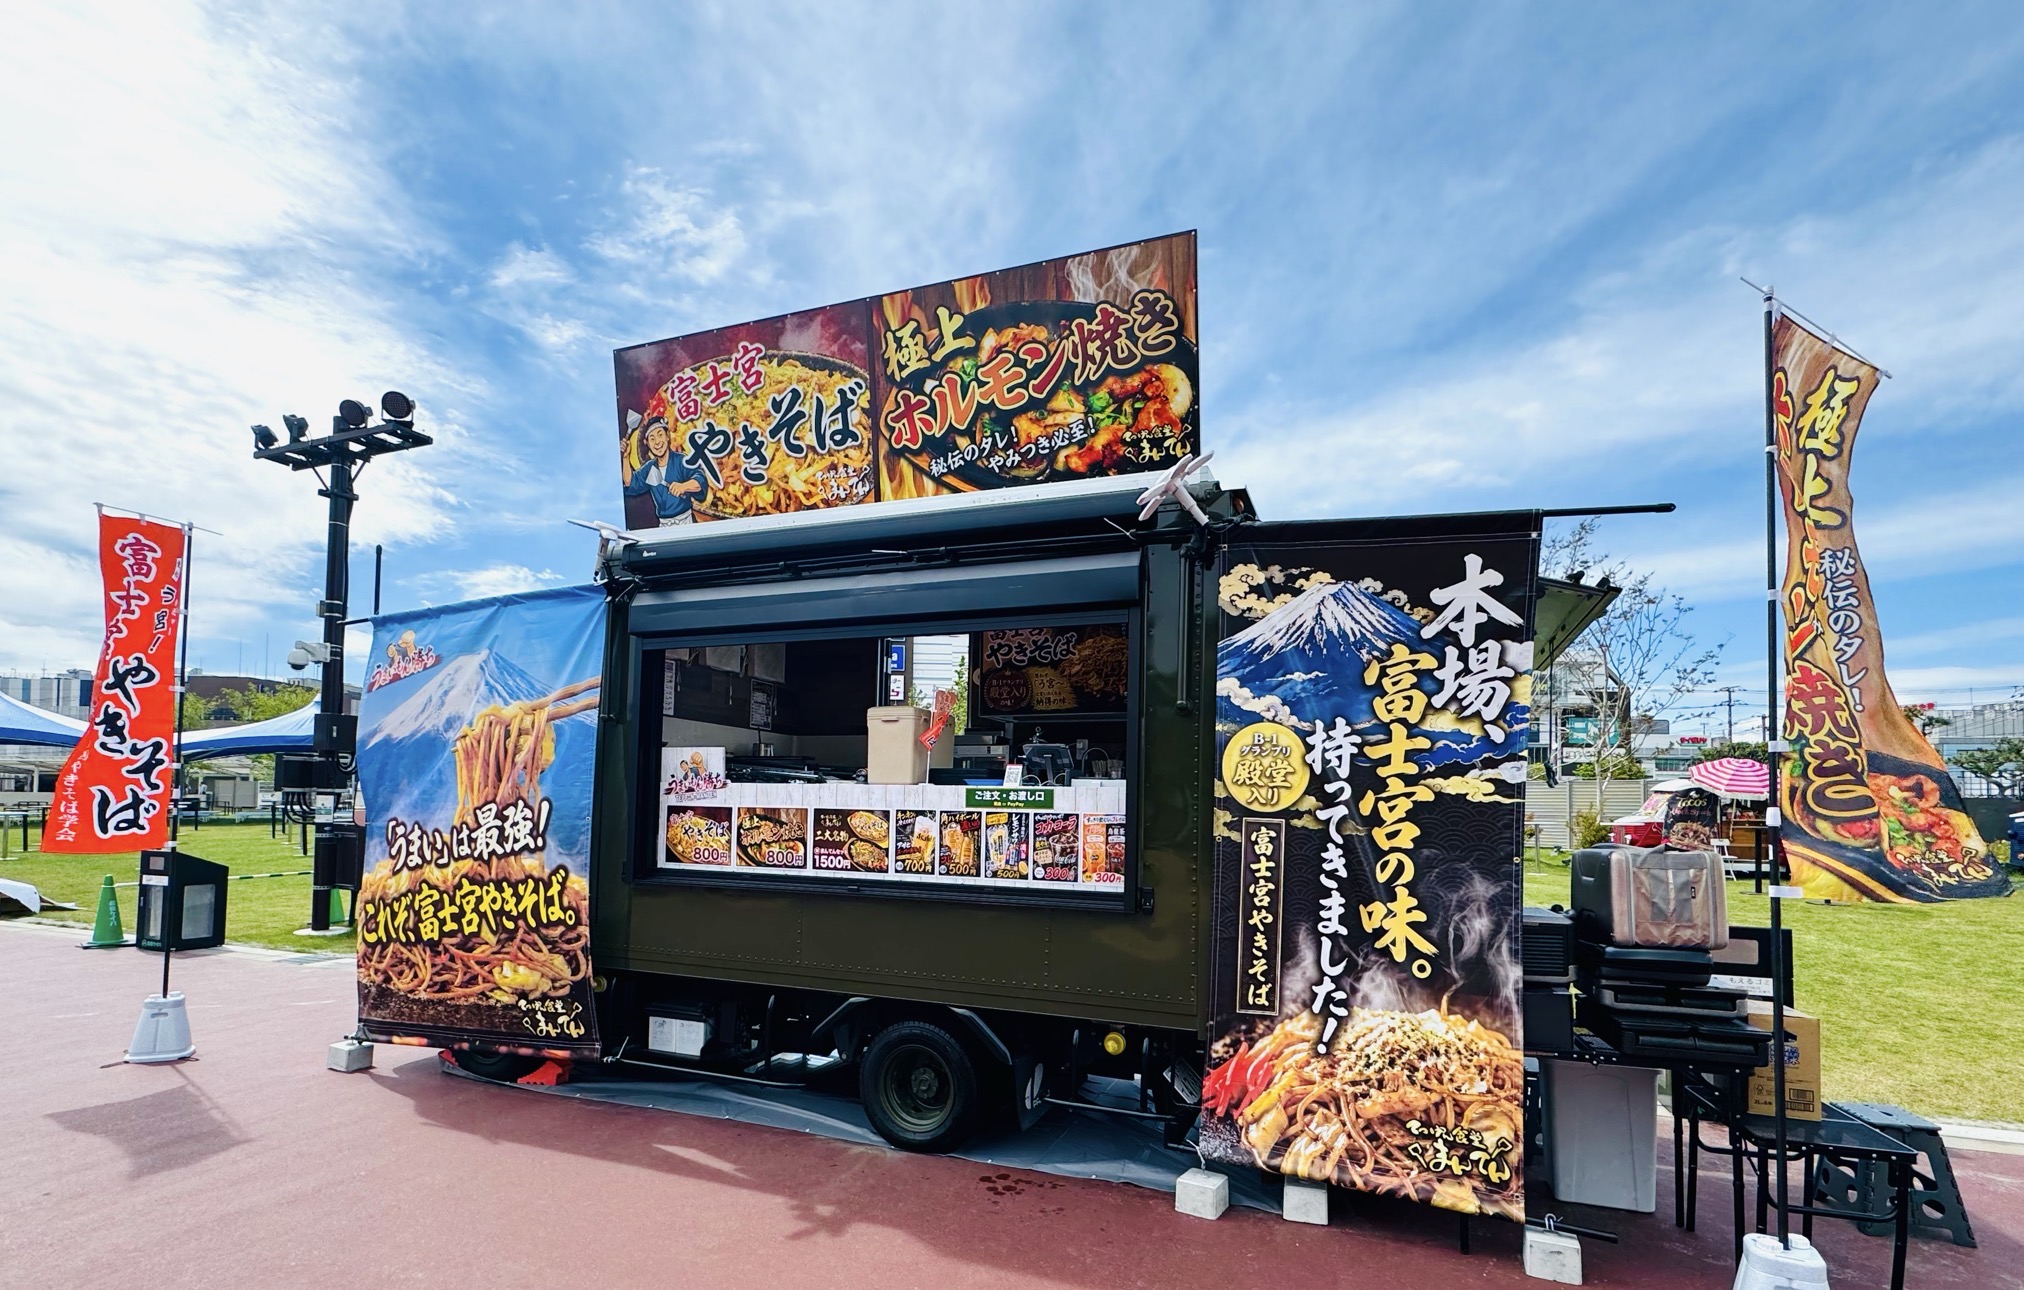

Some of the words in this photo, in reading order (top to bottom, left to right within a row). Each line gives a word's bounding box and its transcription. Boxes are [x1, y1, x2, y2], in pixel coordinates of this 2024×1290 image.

[883, 306, 975, 381] 極上
[889, 293, 1178, 448] ホルモン焼き
[669, 344, 764, 421] 富士宮
[684, 381, 864, 487] やきそば
[988, 417, 1096, 473] やみつき必至！
[929, 425, 1019, 477] 秘伝のタレ！
[1139, 438, 1191, 463] まんてん
[1797, 368, 1860, 526] 極上
[1820, 548, 1868, 713] 秘伝のタレ！
[986, 632, 1078, 668] やきそば
[1420, 553, 1524, 744] 本場、
[989, 687, 1027, 699] 殿堂入り
[1253, 732, 1278, 745] B-1
[1240, 745, 1291, 757] グランプリ
[1232, 759, 1295, 788] 殿堂
[975, 790, 1045, 801] ご注文・お渡し口
[1247, 787, 1279, 805] 入り
[742, 815, 761, 828] 極上
[940, 812, 980, 825] 角ハイボール
[1360, 644, 1439, 979] 富士宮の味。
[386, 800, 550, 872] 「うまい」は最強！
[683, 820, 730, 842] やきそば
[741, 823, 804, 846] ホルモン焼き
[815, 829, 849, 842] 二大名物
[693, 847, 728, 862] 800円
[766, 850, 804, 865] 800円
[814, 855, 851, 870] 1500円
[905, 860, 932, 873] 700円
[949, 863, 977, 876] 500円
[996, 870, 1020, 879] 500円
[1045, 867, 1076, 881] 300円
[1095, 873, 1122, 883] 300円
[1305, 717, 1362, 1054] 持ってきました！
[362, 871, 576, 943] これぞ、富士宮やきそば。
[1248, 826, 1277, 1007] 富士宮やきそば
[1730, 977, 1770, 986] もえるゴミ
[1429, 1138, 1511, 1183] まんてん
